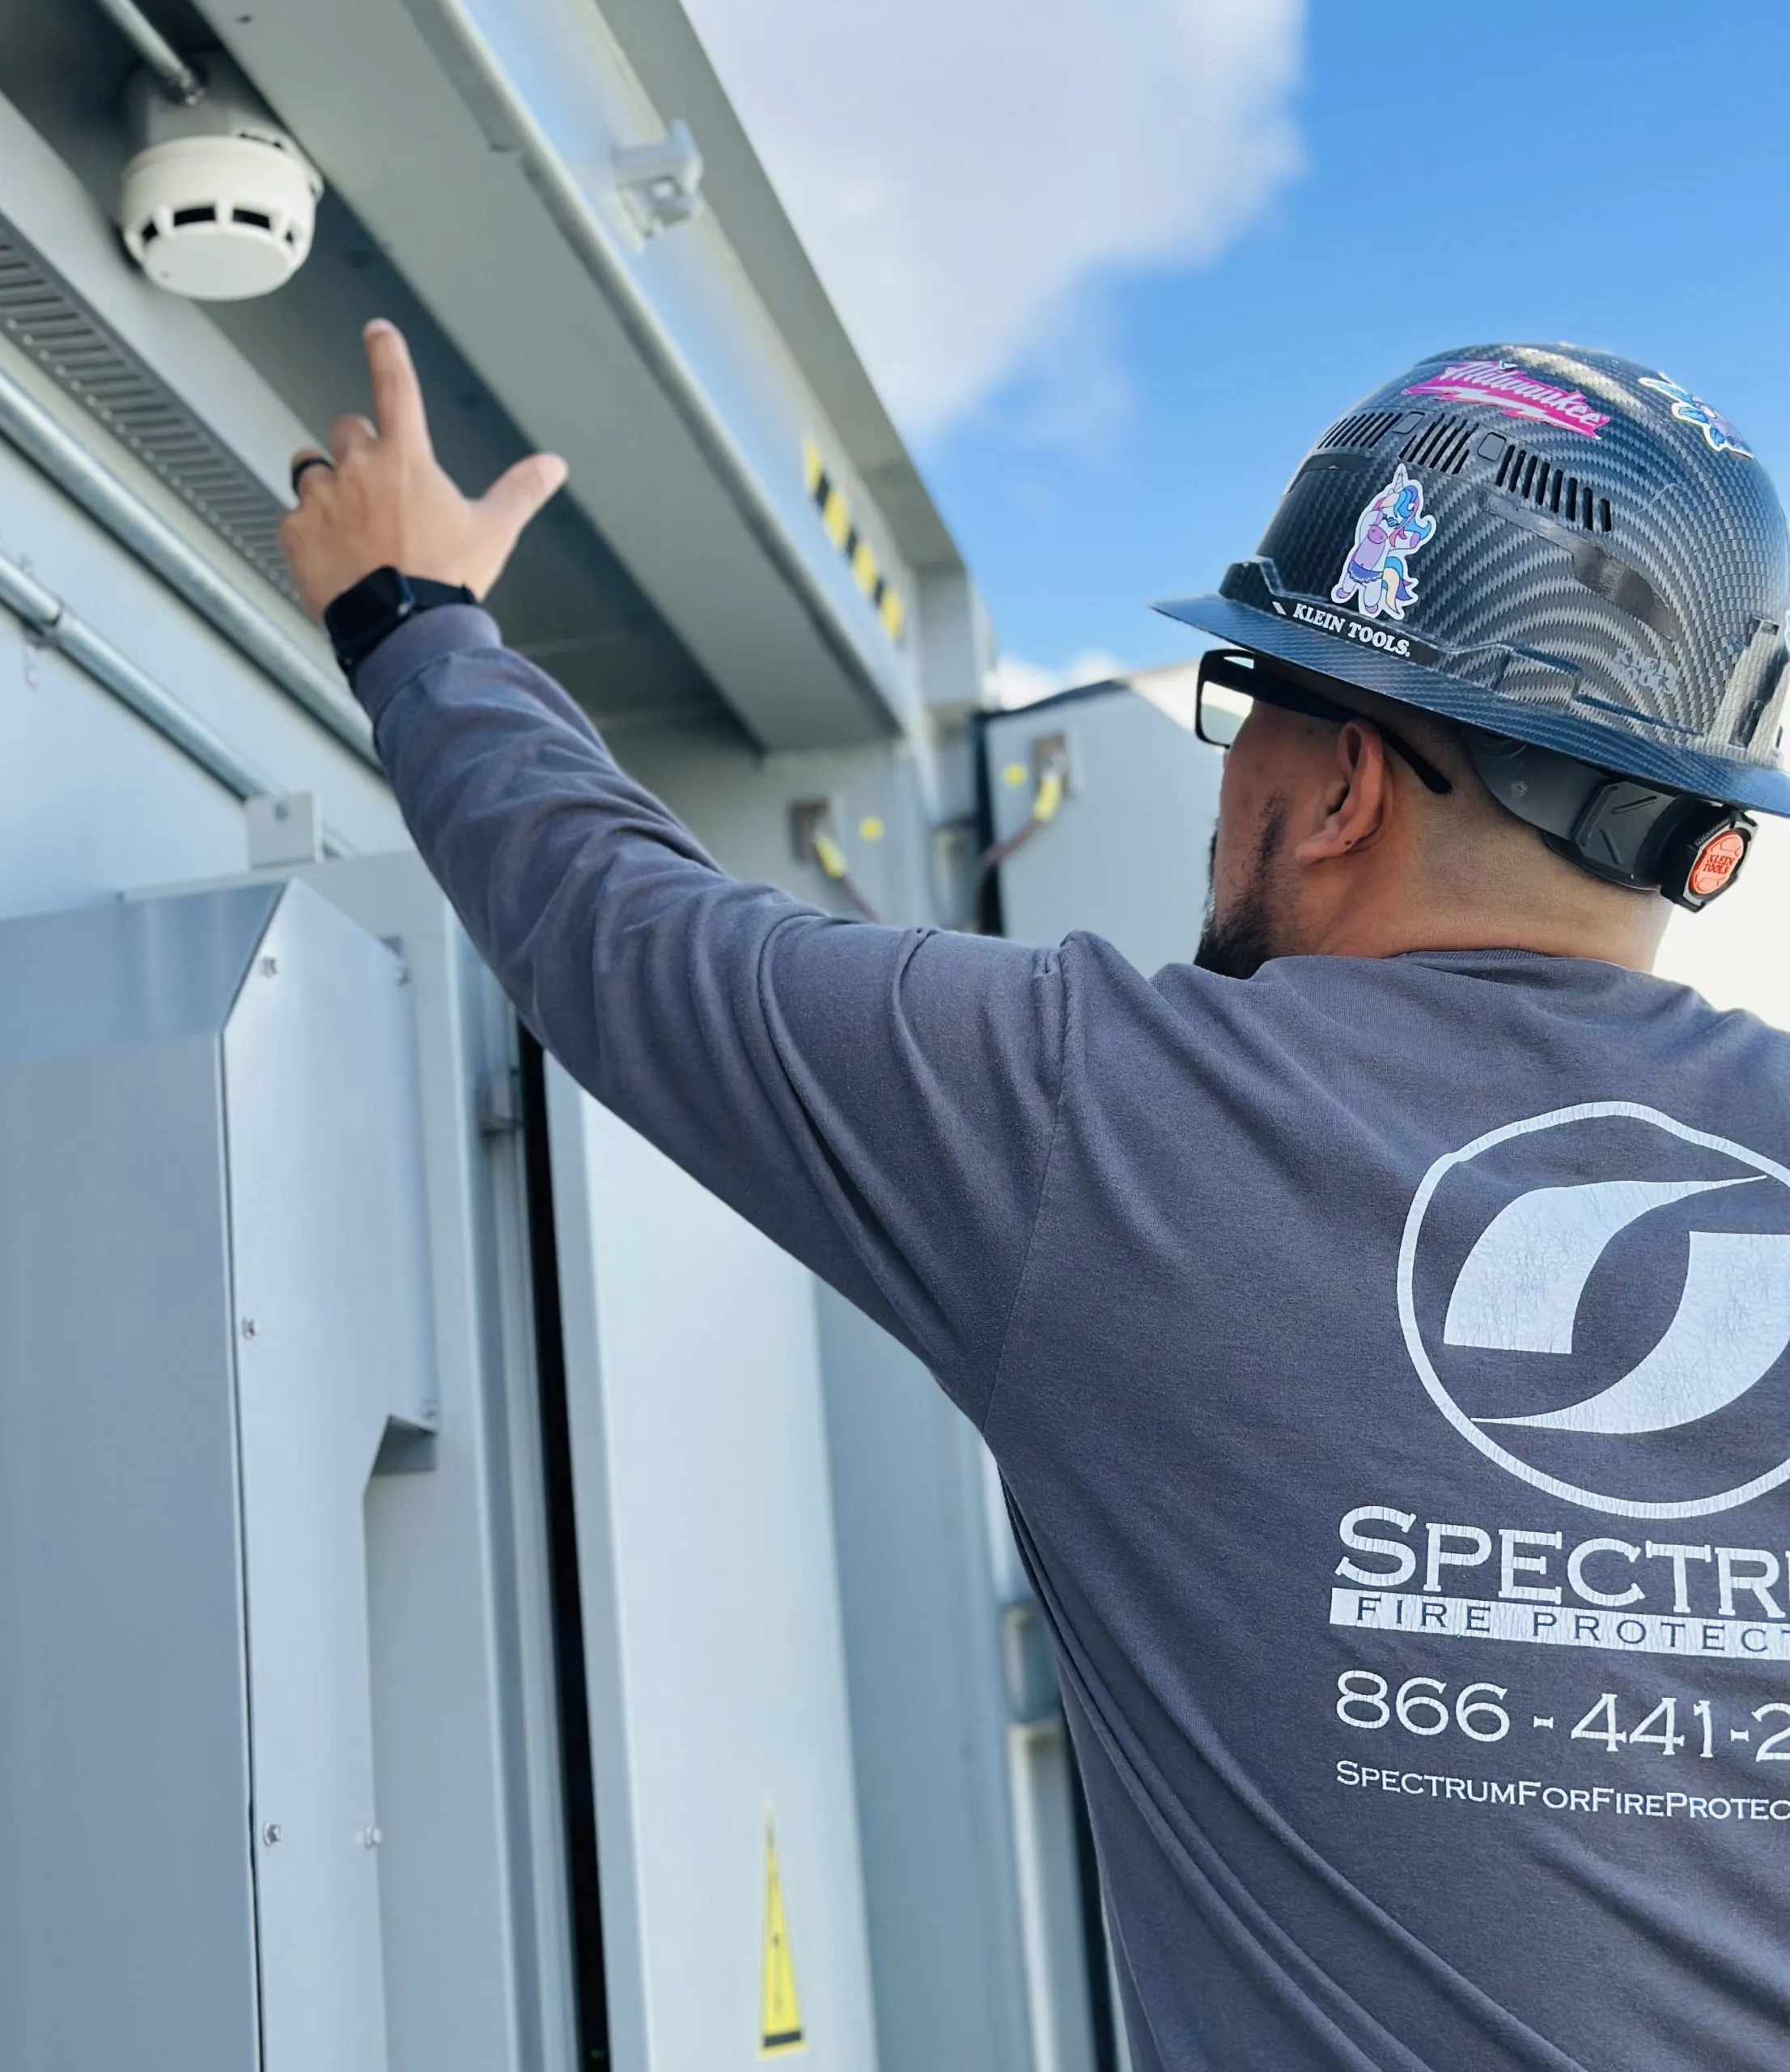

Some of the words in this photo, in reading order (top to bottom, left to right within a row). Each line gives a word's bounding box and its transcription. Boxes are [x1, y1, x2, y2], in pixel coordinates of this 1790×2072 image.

[1439, 360, 1602, 424] Milwaukee
[1292, 603, 1347, 634] KLEIN
[1703, 863, 1729, 875] TOOLS
[1707, 854, 1735, 866] KLEIN
[1334, 1505, 1790, 1619] SPECTR
[1356, 1596, 1491, 1633] FIRE
